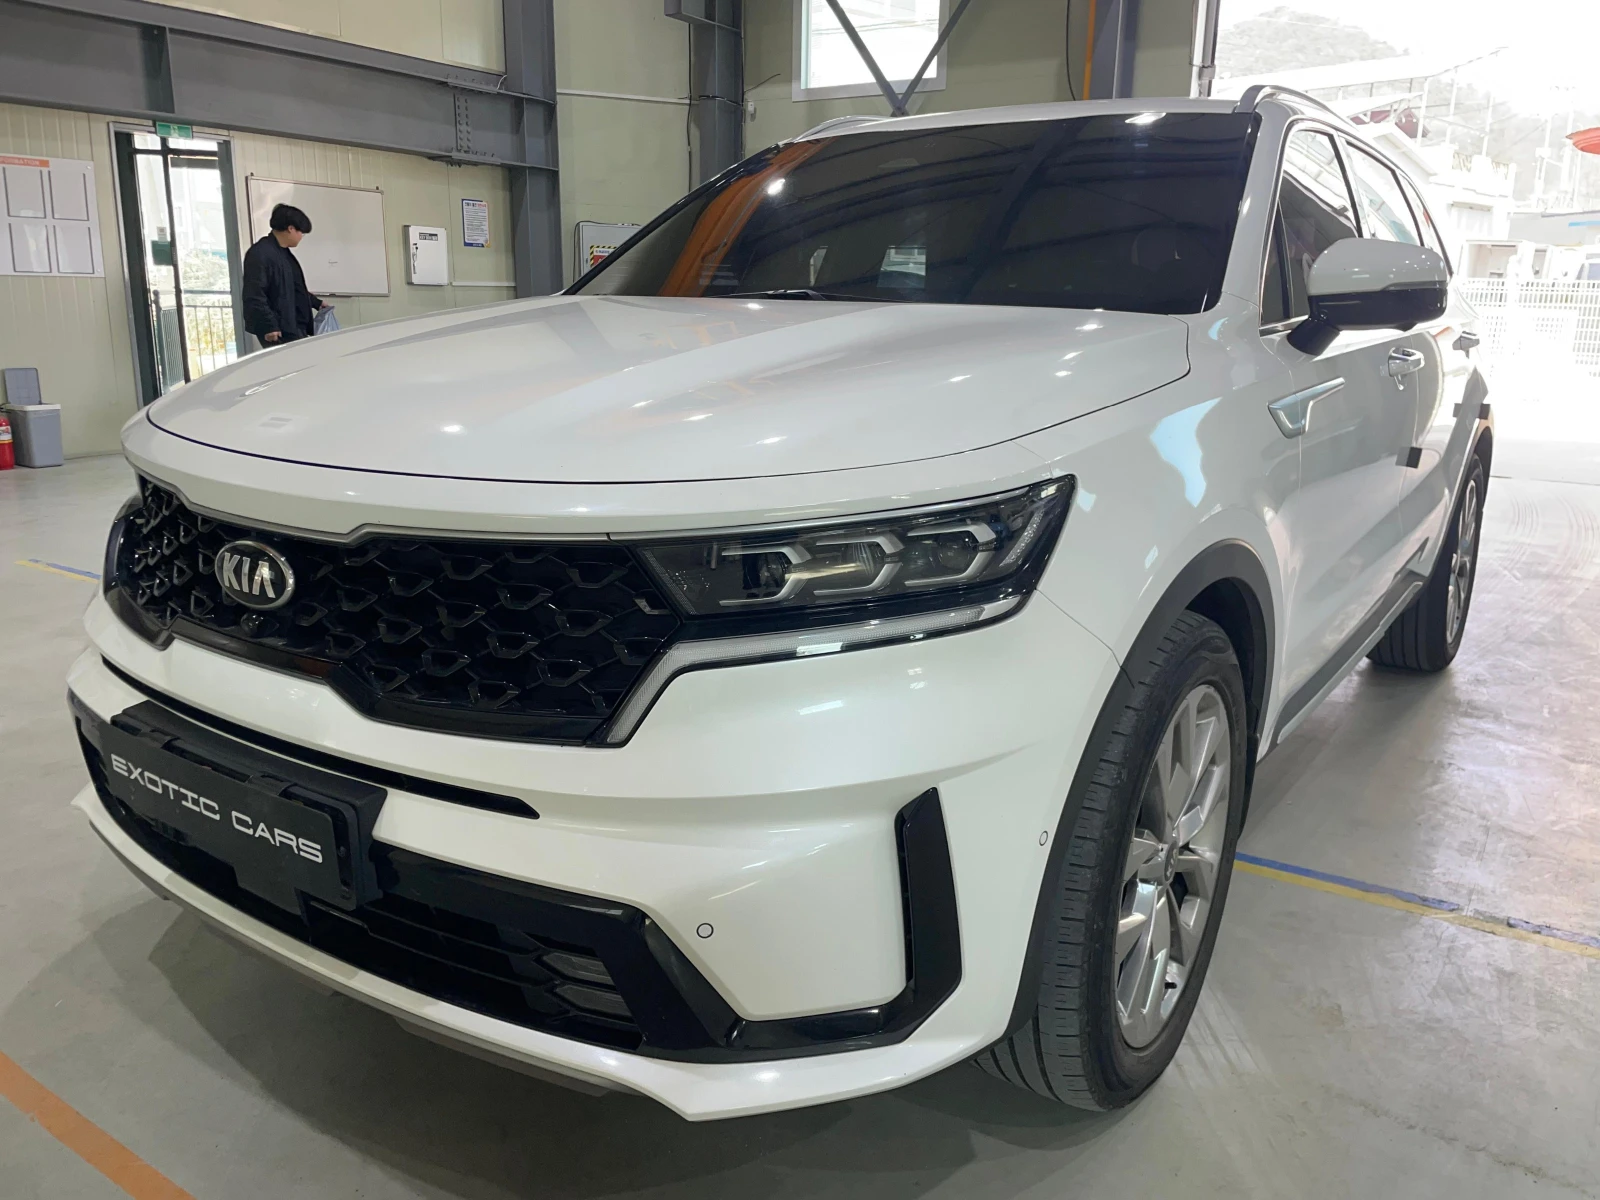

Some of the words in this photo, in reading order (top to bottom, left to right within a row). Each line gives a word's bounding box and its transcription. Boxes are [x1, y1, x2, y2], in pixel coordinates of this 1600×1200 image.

[222, 552, 276, 599] KIA
[110, 753, 220, 821] EXOTIC
[231, 810, 323, 864] CARS
